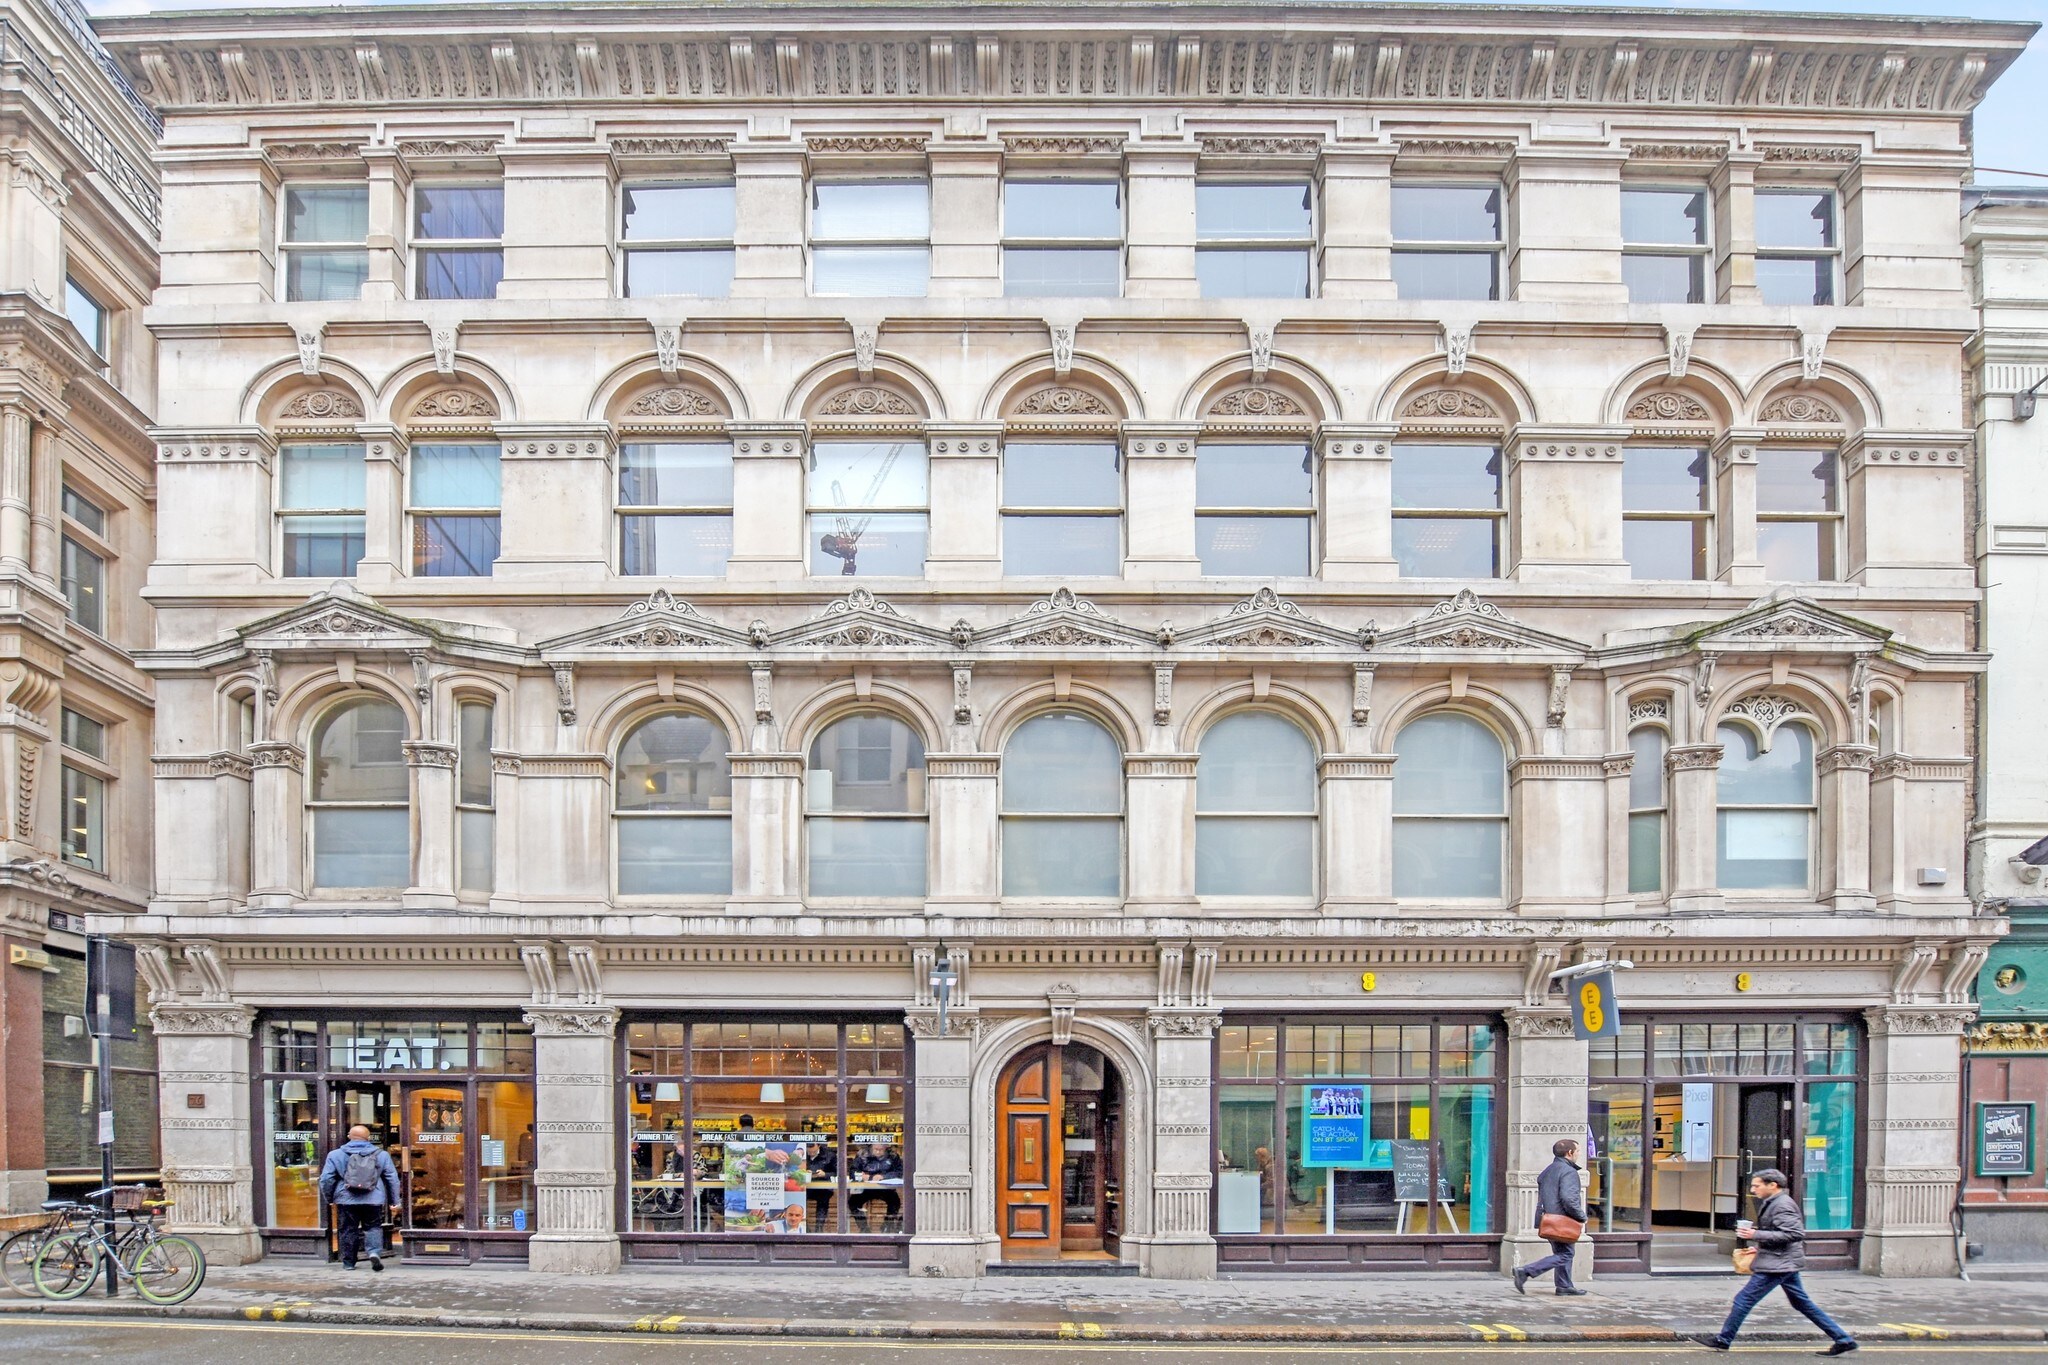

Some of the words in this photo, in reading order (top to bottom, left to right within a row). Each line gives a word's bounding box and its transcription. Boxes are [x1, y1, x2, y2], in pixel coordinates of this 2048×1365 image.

[347, 1037, 451, 1070] EAT.
[1684, 1087, 1711, 1102] Pixel
[1985, 1114, 2020, 1135] SPORT
[2005, 1125, 2023, 1136] LIVE
[275, 1132, 296, 1140] BREAK
[418, 1134, 442, 1142] COFFEE
[637, 1133, 661, 1141] DINNER
[701, 1133, 723, 1141] BREAK
[724, 1133, 738, 1141] FAST
[743, 1133, 765, 1141] LUNCH
[789, 1134, 813, 1142] DINNER
[814, 1134, 828, 1142] TIME
[854, 1134, 879, 1142] COFFEE
